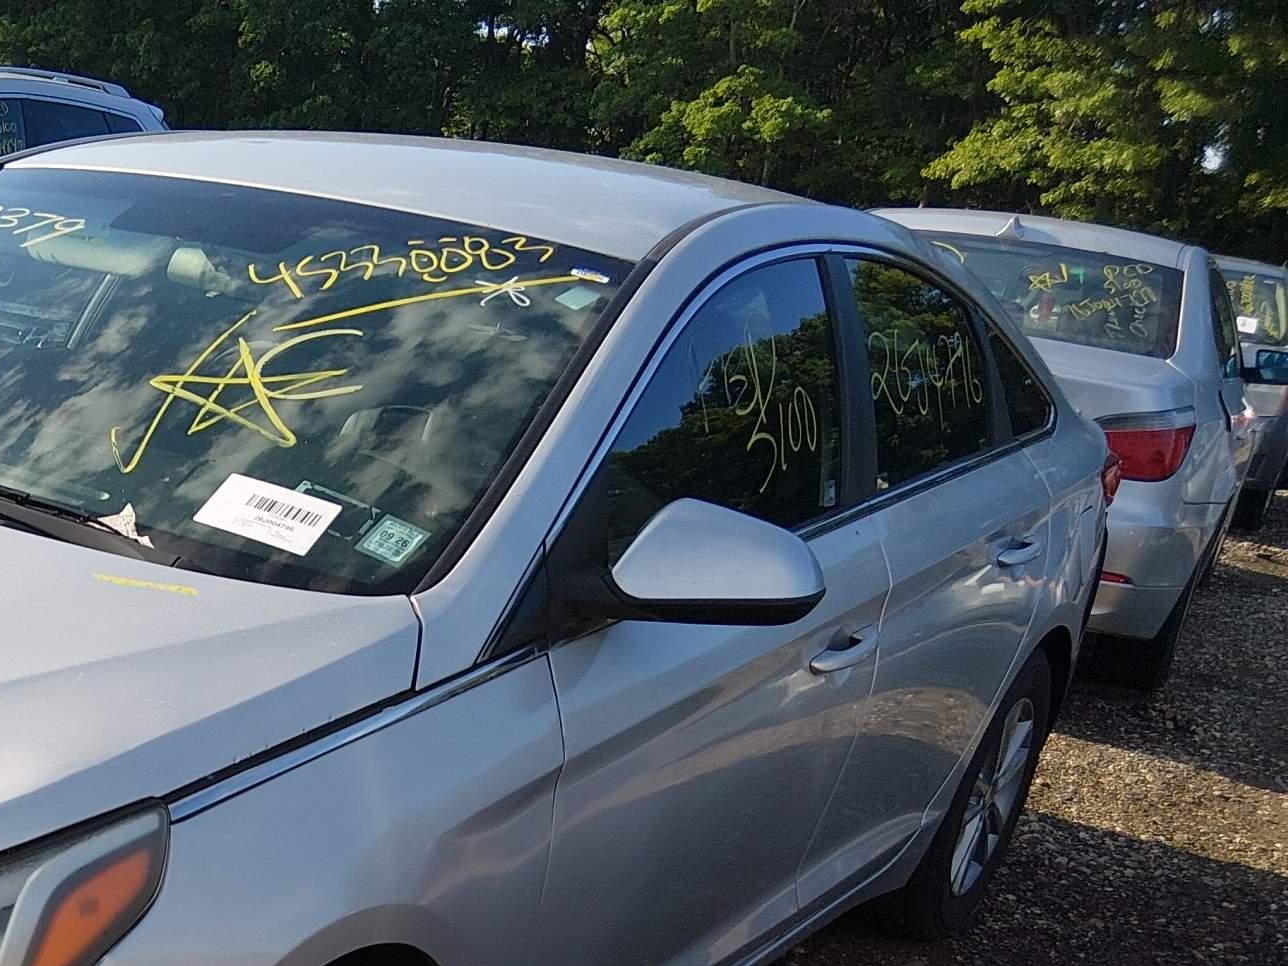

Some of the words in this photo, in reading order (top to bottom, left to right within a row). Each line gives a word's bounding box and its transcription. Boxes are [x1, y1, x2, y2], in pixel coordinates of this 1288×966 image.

[248, 236, 556, 299] 45330083
[379, 530, 394, 542] 09
[395, 535, 410, 549] 26
